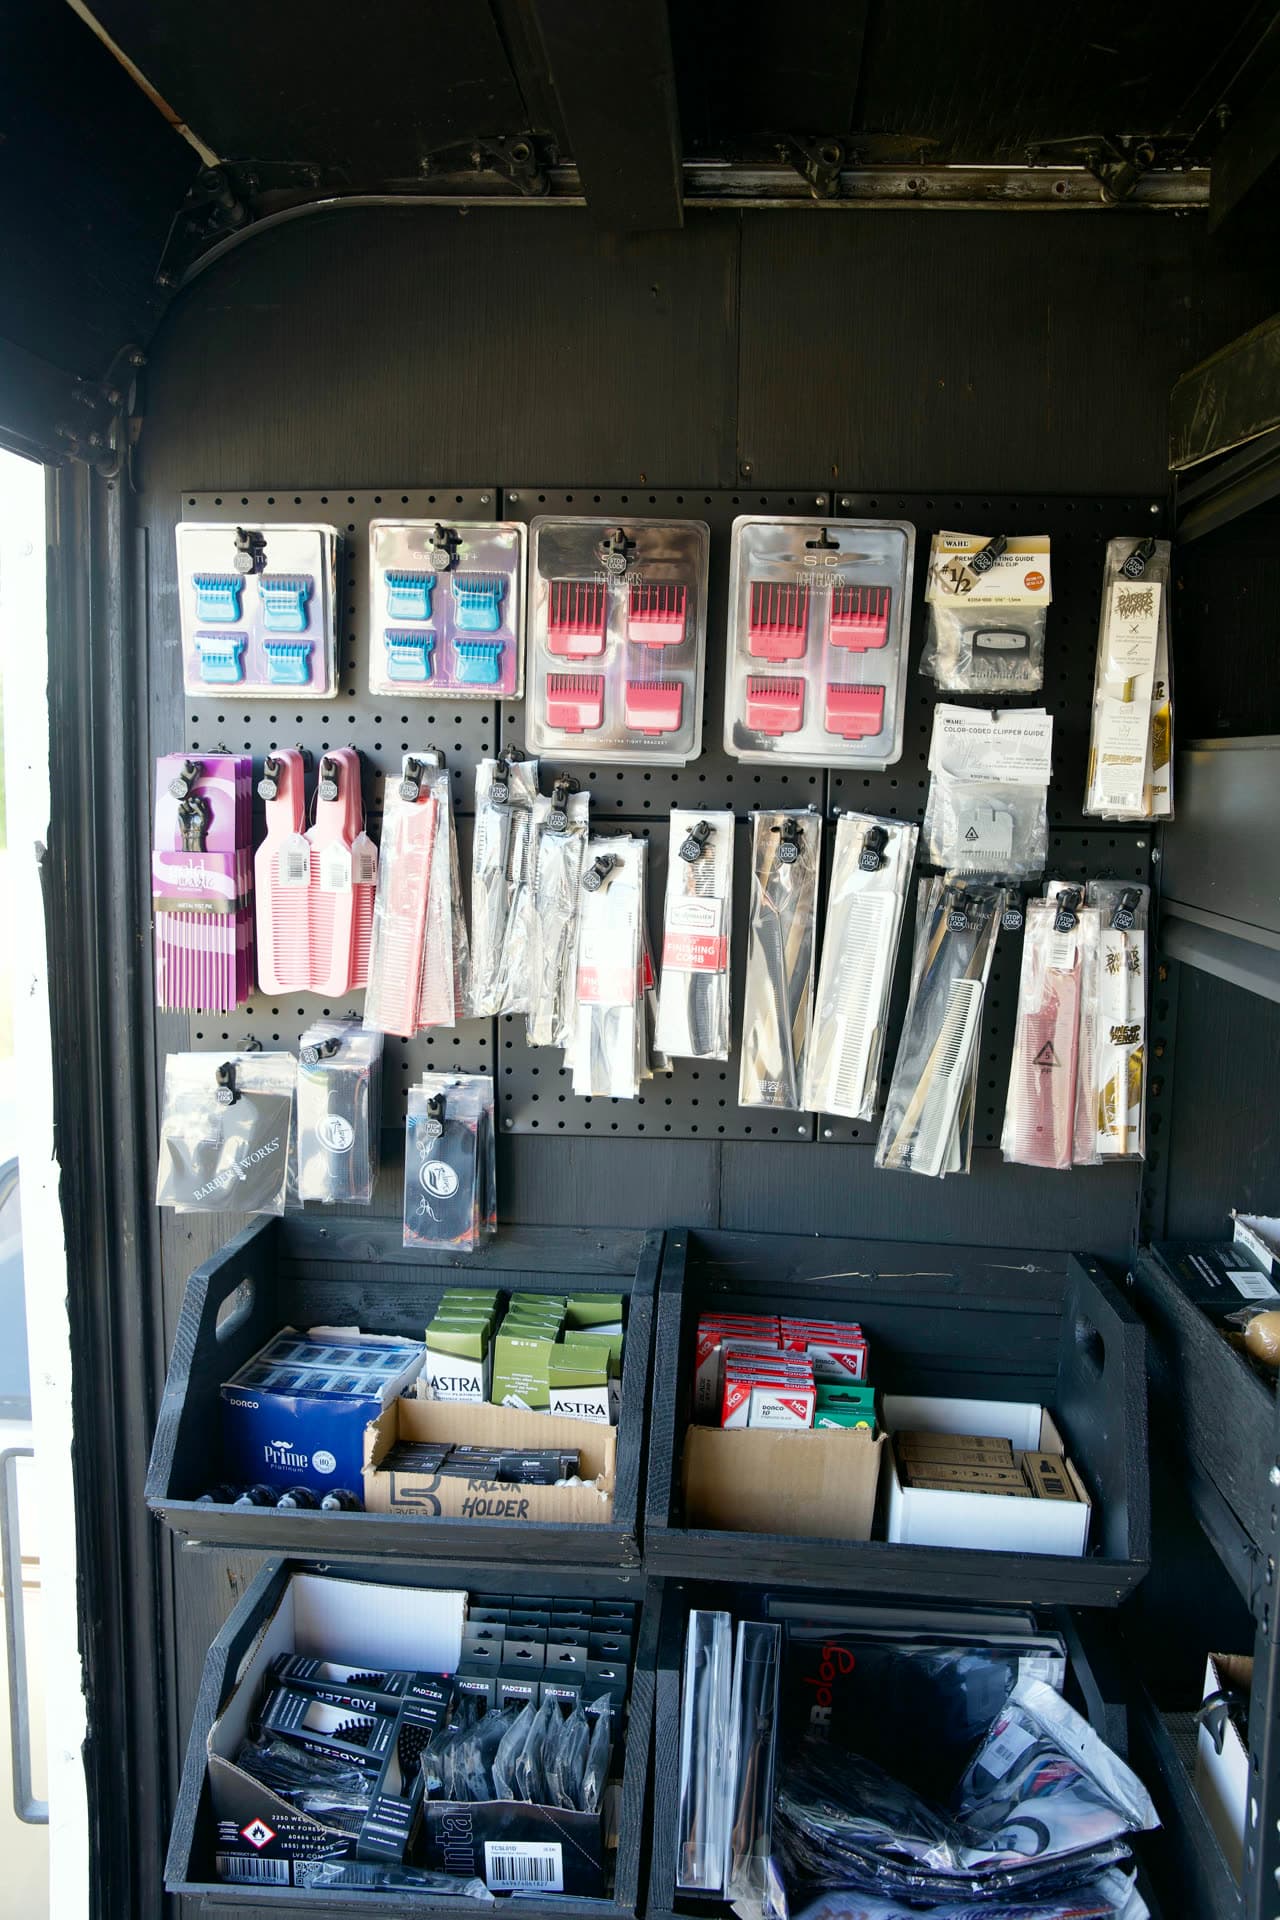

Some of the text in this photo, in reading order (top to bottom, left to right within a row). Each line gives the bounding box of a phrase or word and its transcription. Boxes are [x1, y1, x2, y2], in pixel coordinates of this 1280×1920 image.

[944, 727, 992, 735] COLOR-CODED
[193, 1140, 280, 1200] BARBER WORKS
[843, 1356, 856, 1369] HQ
[431, 1375, 481, 1392] ASTRA
[230, 1399, 259, 1409] DORCO
[727, 1393, 741, 1407] HQ
[791, 1400, 806, 1414] HQ
[553, 1400, 607, 1416] ASTRA
[264, 1445, 308, 1468] Prime
[270, 1463, 304, 1473] Platinum
[462, 1497, 530, 1519] HOLDER
[413, 1686, 443, 1700] FADEZER
[459, 1682, 490, 1690] FADEZER
[502, 1685, 533, 1693] FADEZER
[316, 1691, 376, 1712] FADEZER
[304, 1742, 366, 1765] FADEZER
